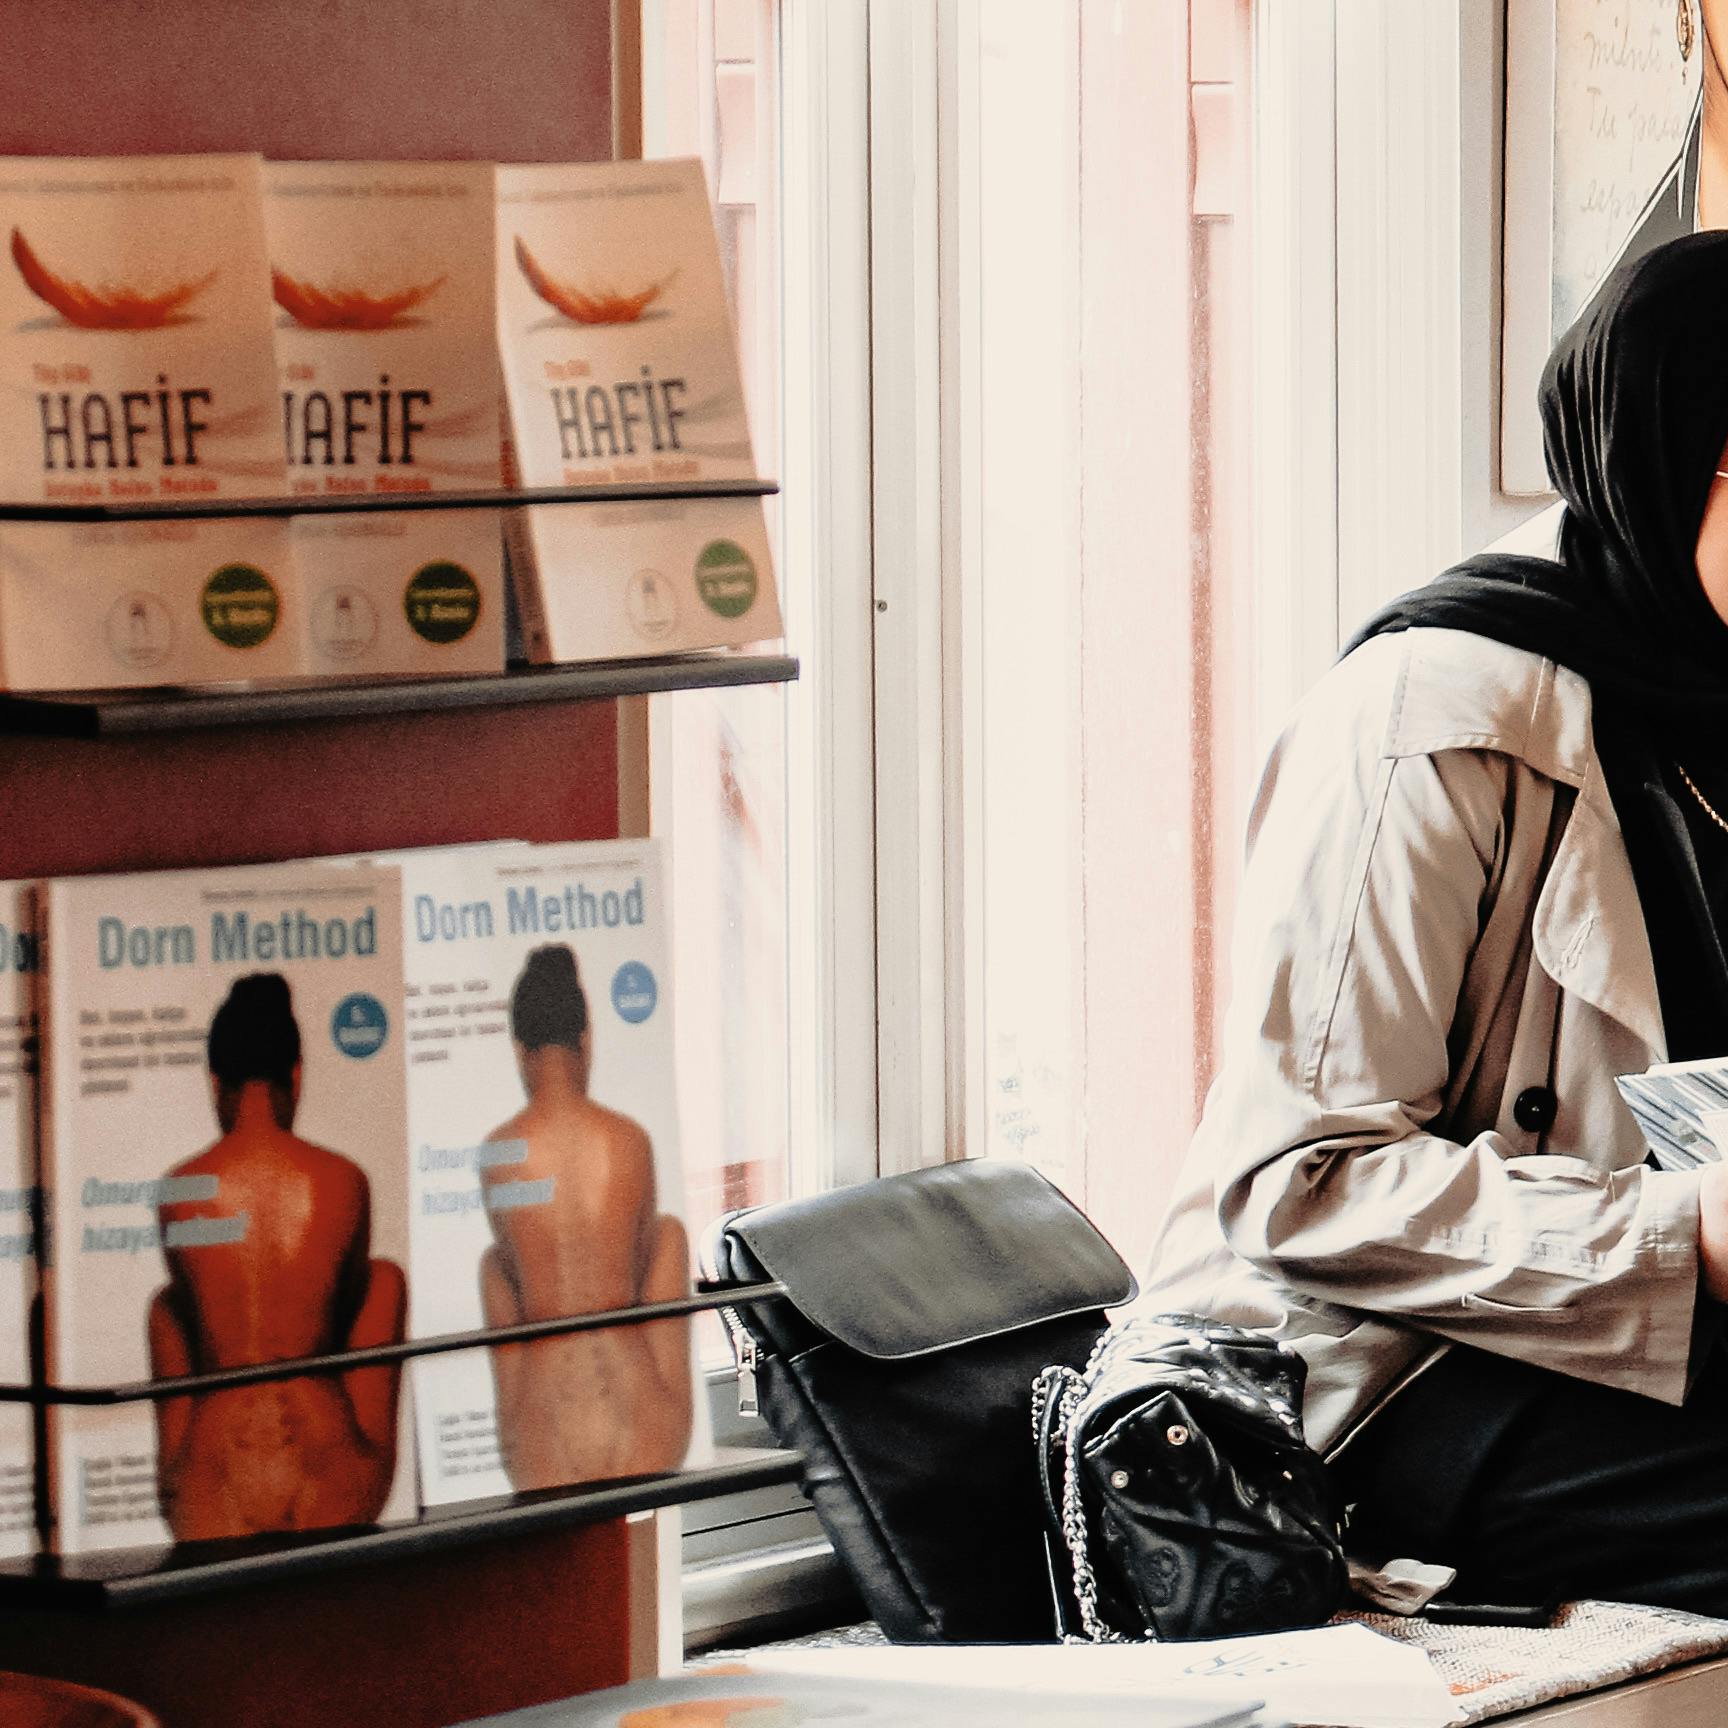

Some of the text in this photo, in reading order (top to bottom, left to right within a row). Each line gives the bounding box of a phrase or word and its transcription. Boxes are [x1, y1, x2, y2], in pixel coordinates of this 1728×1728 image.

[37, 373, 213, 469] HAFİF
[550, 364, 688, 459] HAFİF
[99, 915, 196, 971] Dorn
[211, 906, 379, 963] Method
[414, 879, 646, 945] Dorn Method
